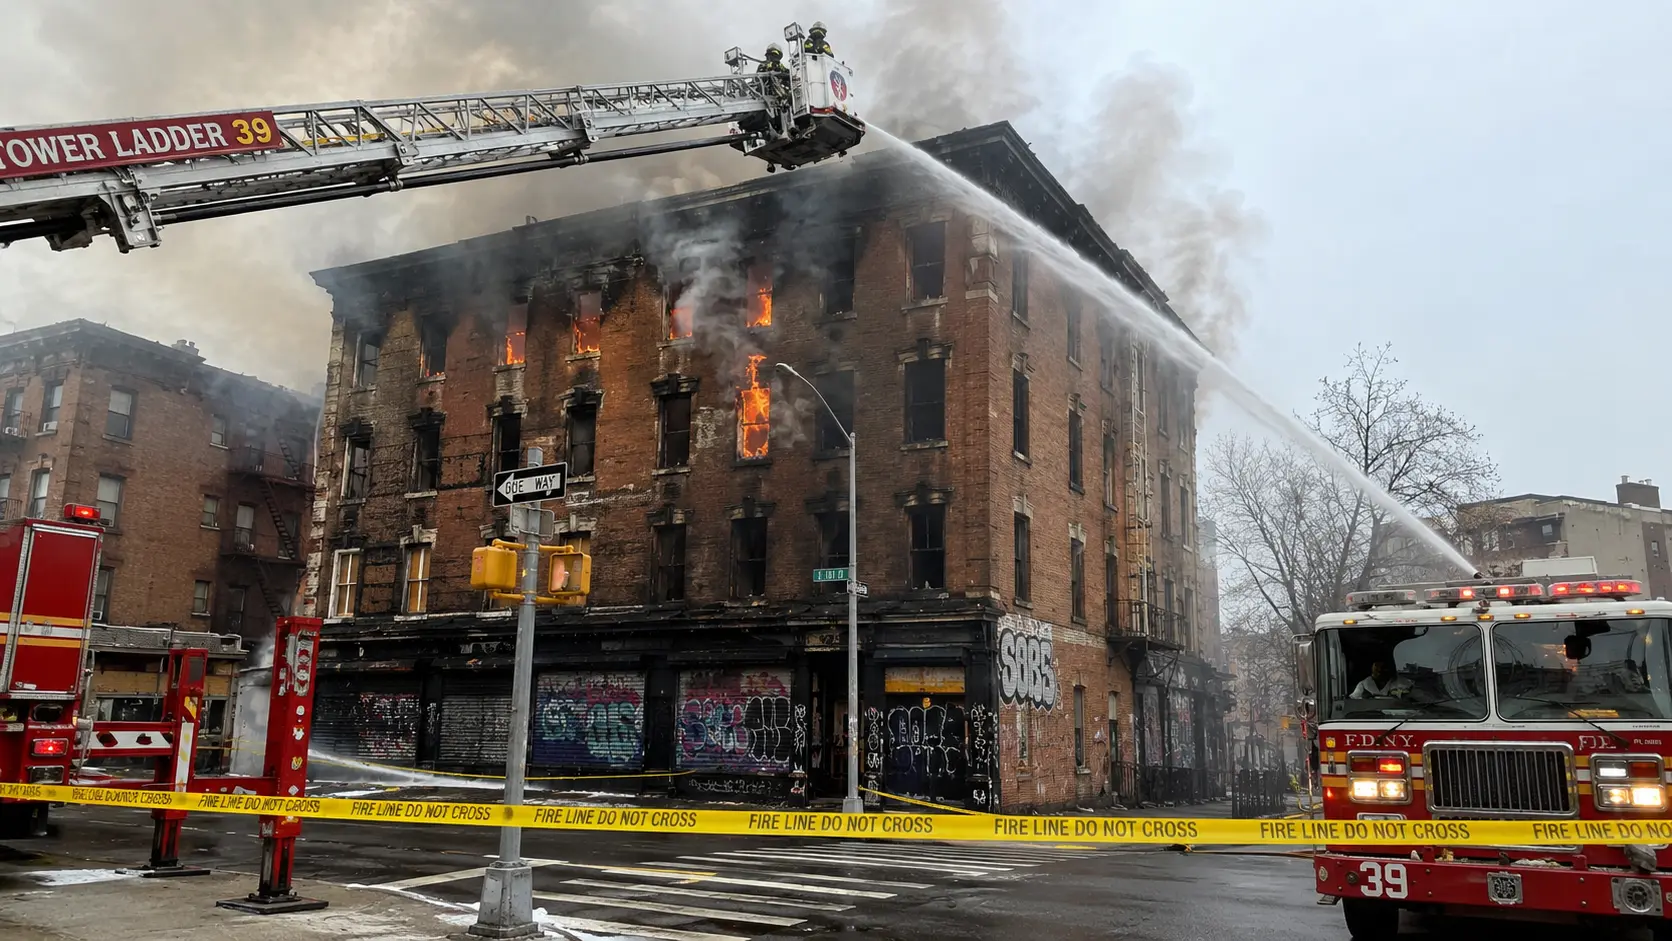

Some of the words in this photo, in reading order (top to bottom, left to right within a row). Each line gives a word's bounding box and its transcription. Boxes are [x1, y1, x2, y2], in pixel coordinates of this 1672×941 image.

[108, 122, 228, 158] LADDER
[231, 117, 272, 145] 39
[351, 801, 376, 815] FIRE
[424, 804, 450, 818] NOT
[451, 805, 492, 820] CROSS
[534, 808, 563, 824] FIRE
[565, 809, 595, 824] LINE
[597, 810, 617, 826] DO
[619, 811, 649, 826] NOT
[651, 811, 698, 827] CROSS
[749, 813, 781, 830] FIRE
[784, 814, 817, 831] LINE
[821, 815, 843, 831] DO
[846, 816, 878, 832] NOT
[882, 816, 933, 833] CROSS
[994, 818, 1028, 835] FIRE
[1033, 819, 1069, 836] LINE
[1074, 820, 1098, 837] DO
[1103, 820, 1137, 837] NOT
[1142, 820, 1199, 838] CROSS
[1260, 822, 1296, 839] FIRE
[1301, 822, 1339, 839] LINE
[1344, 822, 1368, 839] DO
[1373, 822, 1408, 839] NOT
[1413, 822, 1470, 839] CROSS
[1532, 823, 1571, 839] FIRE
[1575, 823, 1614, 839] LINE
[1616, 823, 1643, 839] DO
[1646, 822, 1672, 839] NO
[1360, 861, 1408, 899] 39
